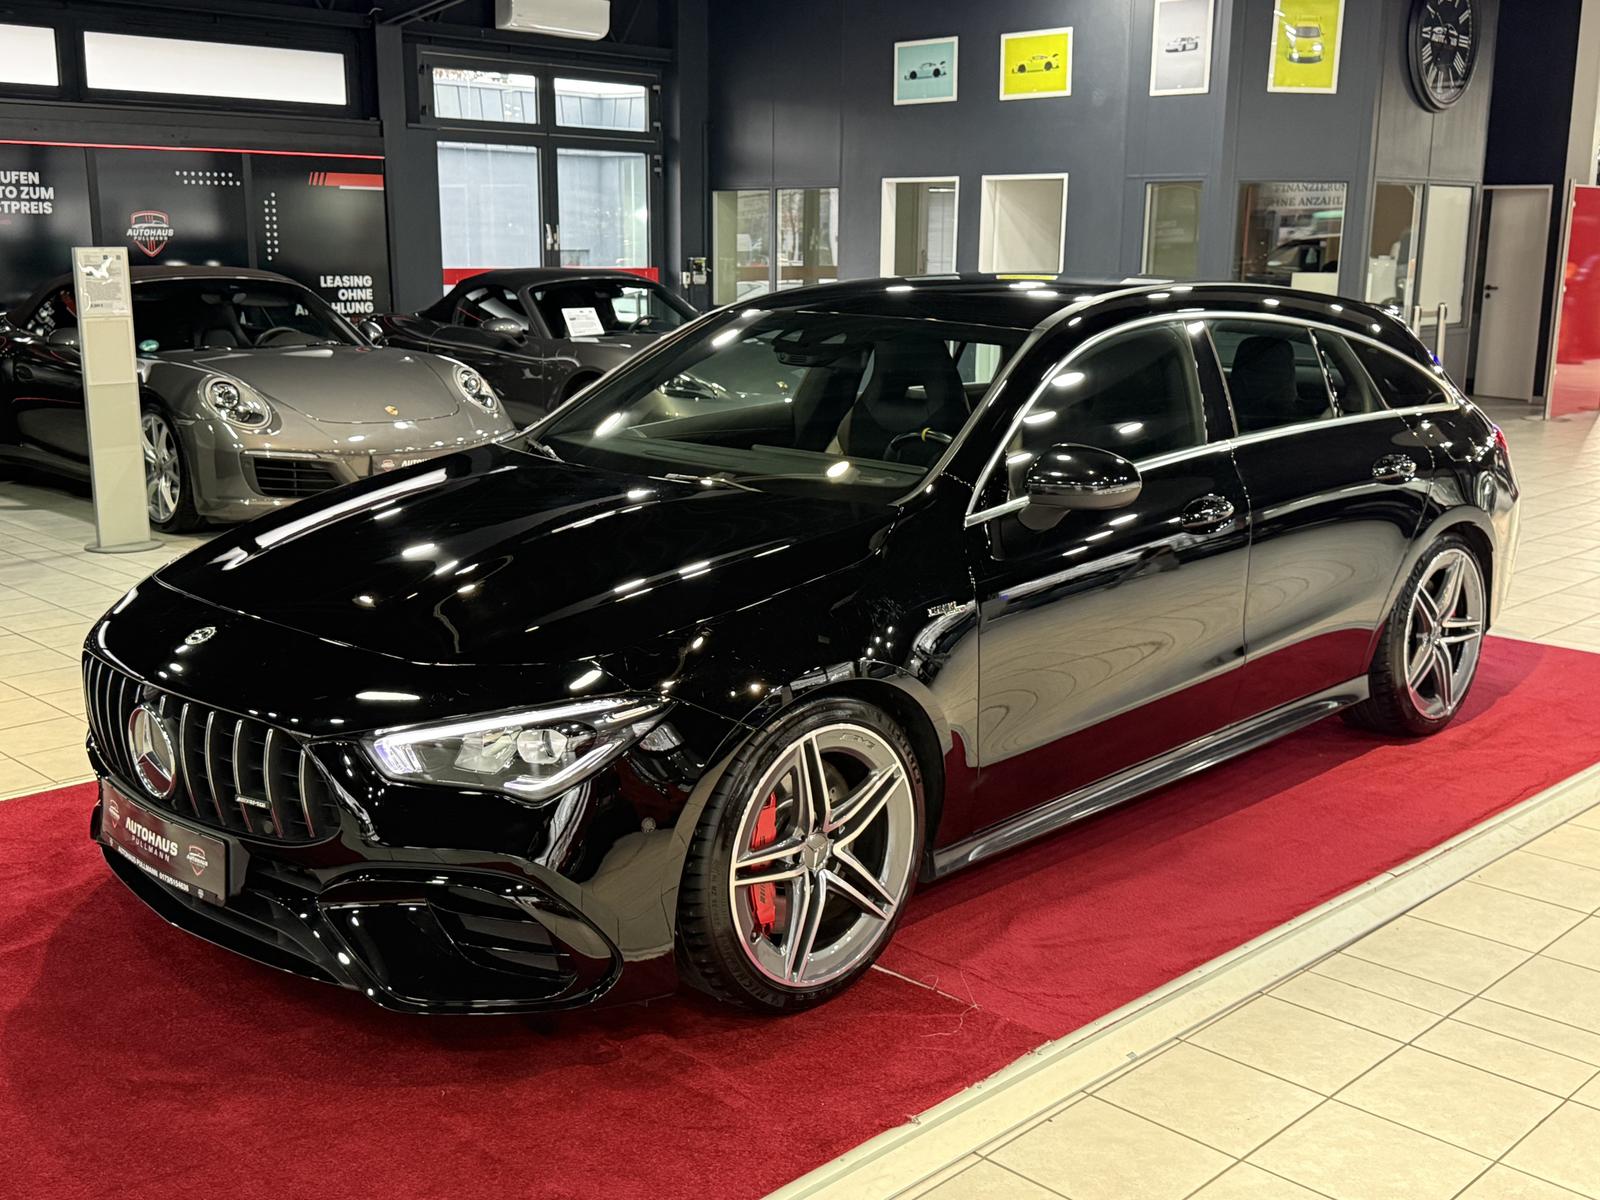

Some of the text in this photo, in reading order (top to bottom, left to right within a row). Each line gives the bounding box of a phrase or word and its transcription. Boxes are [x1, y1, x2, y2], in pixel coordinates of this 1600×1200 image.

[20, 186, 55, 200] ZUM
[0, 201, 53, 215] TPREIS
[126, 229, 174, 237] AUTOHAUS
[320, 275, 373, 288] LEASING
[338, 289, 374, 301] OHNE
[125, 816, 178, 857] AUTOHAUS
[131, 834, 170, 862] PULLMANN
